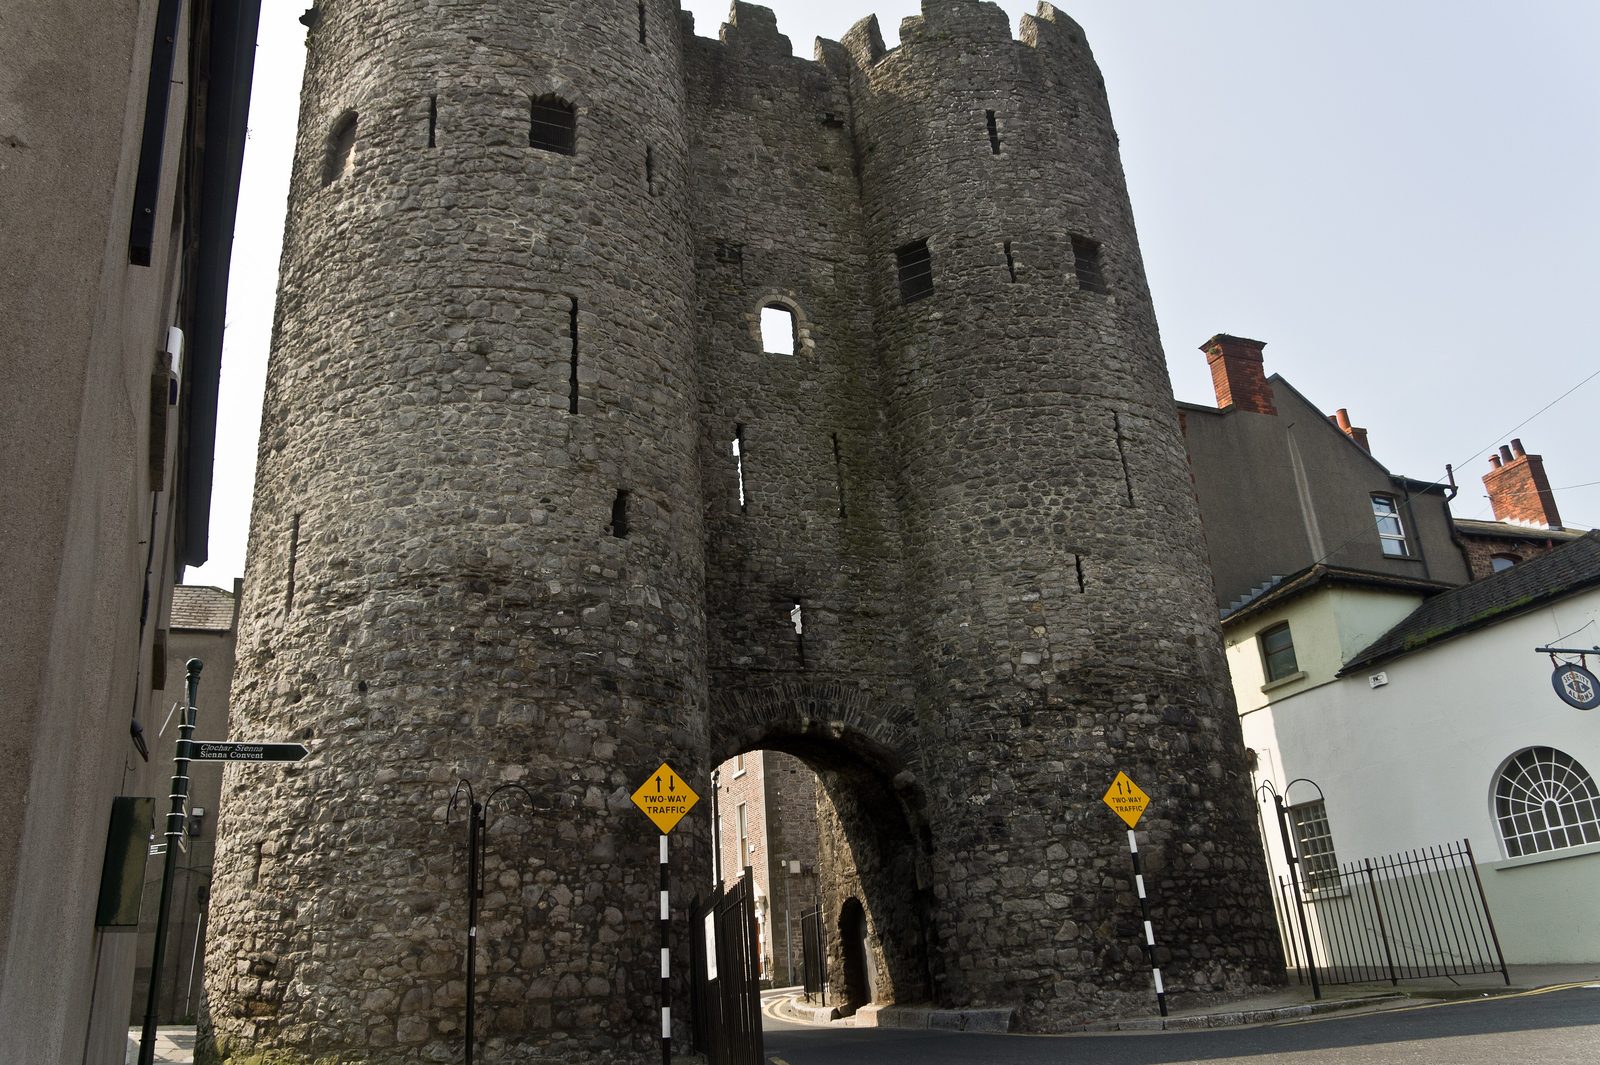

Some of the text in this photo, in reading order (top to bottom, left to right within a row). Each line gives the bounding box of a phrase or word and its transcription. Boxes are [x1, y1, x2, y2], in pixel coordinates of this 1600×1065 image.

[200, 743, 264, 752] Clochar Sienna
[230, 751, 264, 759] Convent
[644, 795, 687, 803] TWO-WAY
[647, 806, 686, 814] TRAFFIC
